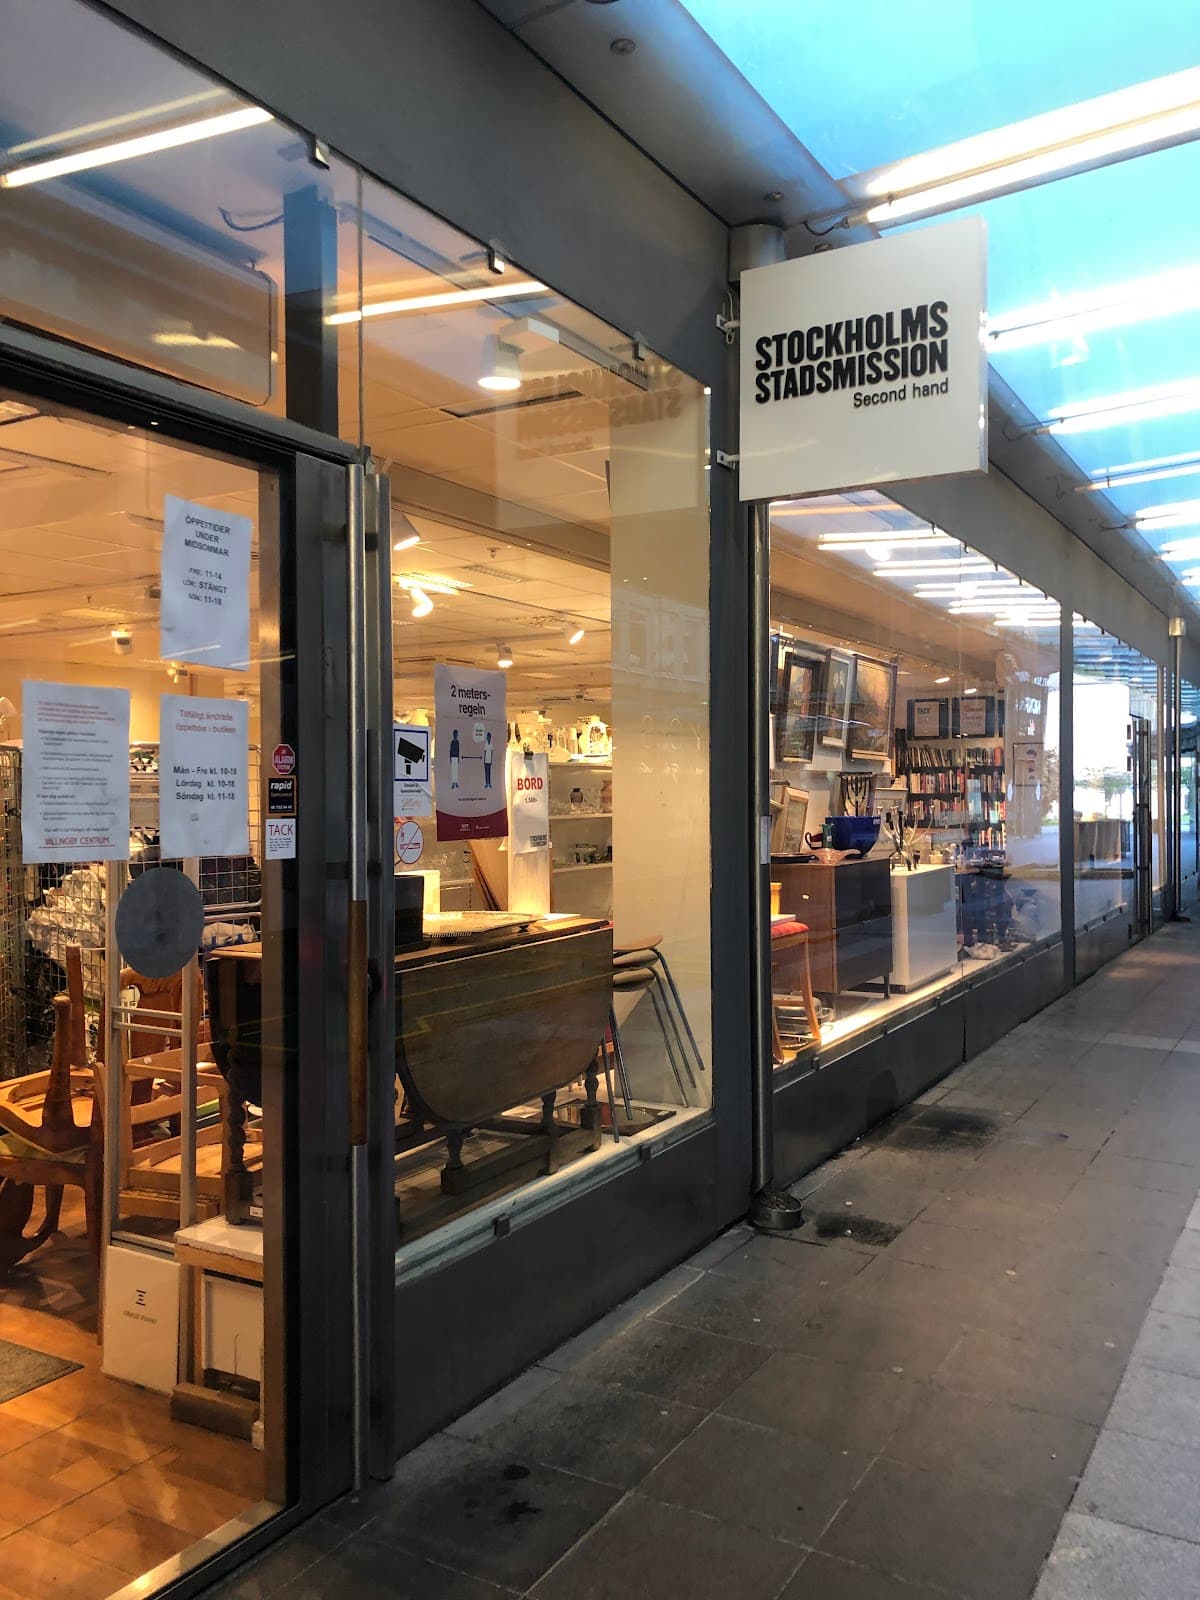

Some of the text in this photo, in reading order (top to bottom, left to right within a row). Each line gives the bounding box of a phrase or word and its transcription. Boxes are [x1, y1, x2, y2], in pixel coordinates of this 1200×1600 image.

[755, 301, 949, 371] STOCKHOLMS
[755, 338, 949, 404] STADSMISSION
[853, 377, 949, 408] Second hand
[185, 514, 231, 534] ÖPPETTIDER
[195, 530, 220, 543] UNDER
[184, 538, 229, 556] MIDSOMMAR
[198, 581, 227, 594] STÄNGT
[450, 685, 491, 700] 2 meters-
[458, 703, 486, 717] regeln
[173, 765, 190, 774] Mån
[196, 766, 208, 775] Fre
[175, 779, 202, 789] Lördag
[270, 780, 292, 791] rapid
[517, 777, 544, 790] BORD
[175, 791, 204, 801] Söndag
[268, 824, 294, 836] TACK
